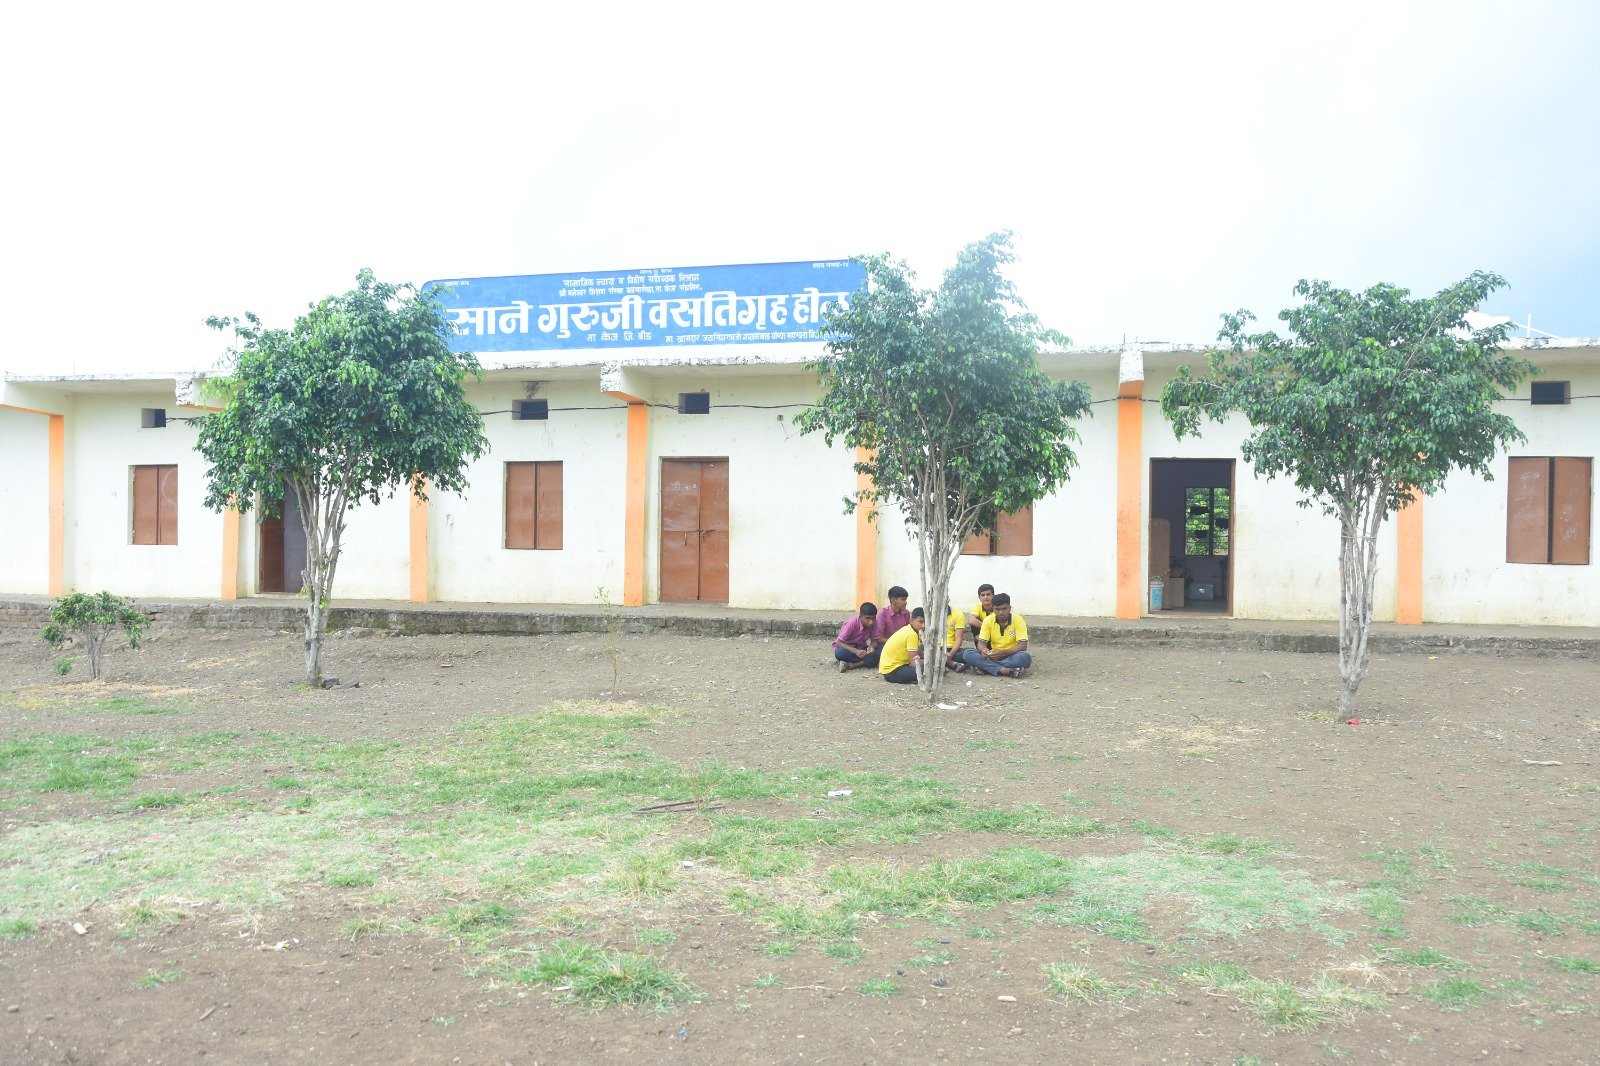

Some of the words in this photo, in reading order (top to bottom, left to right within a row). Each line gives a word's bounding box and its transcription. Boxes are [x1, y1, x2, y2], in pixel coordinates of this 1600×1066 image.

[446, 300, 534, 336] साने
[538, 295, 645, 340] गुरुजी
[647, 290, 790, 331] वसतिगृह
